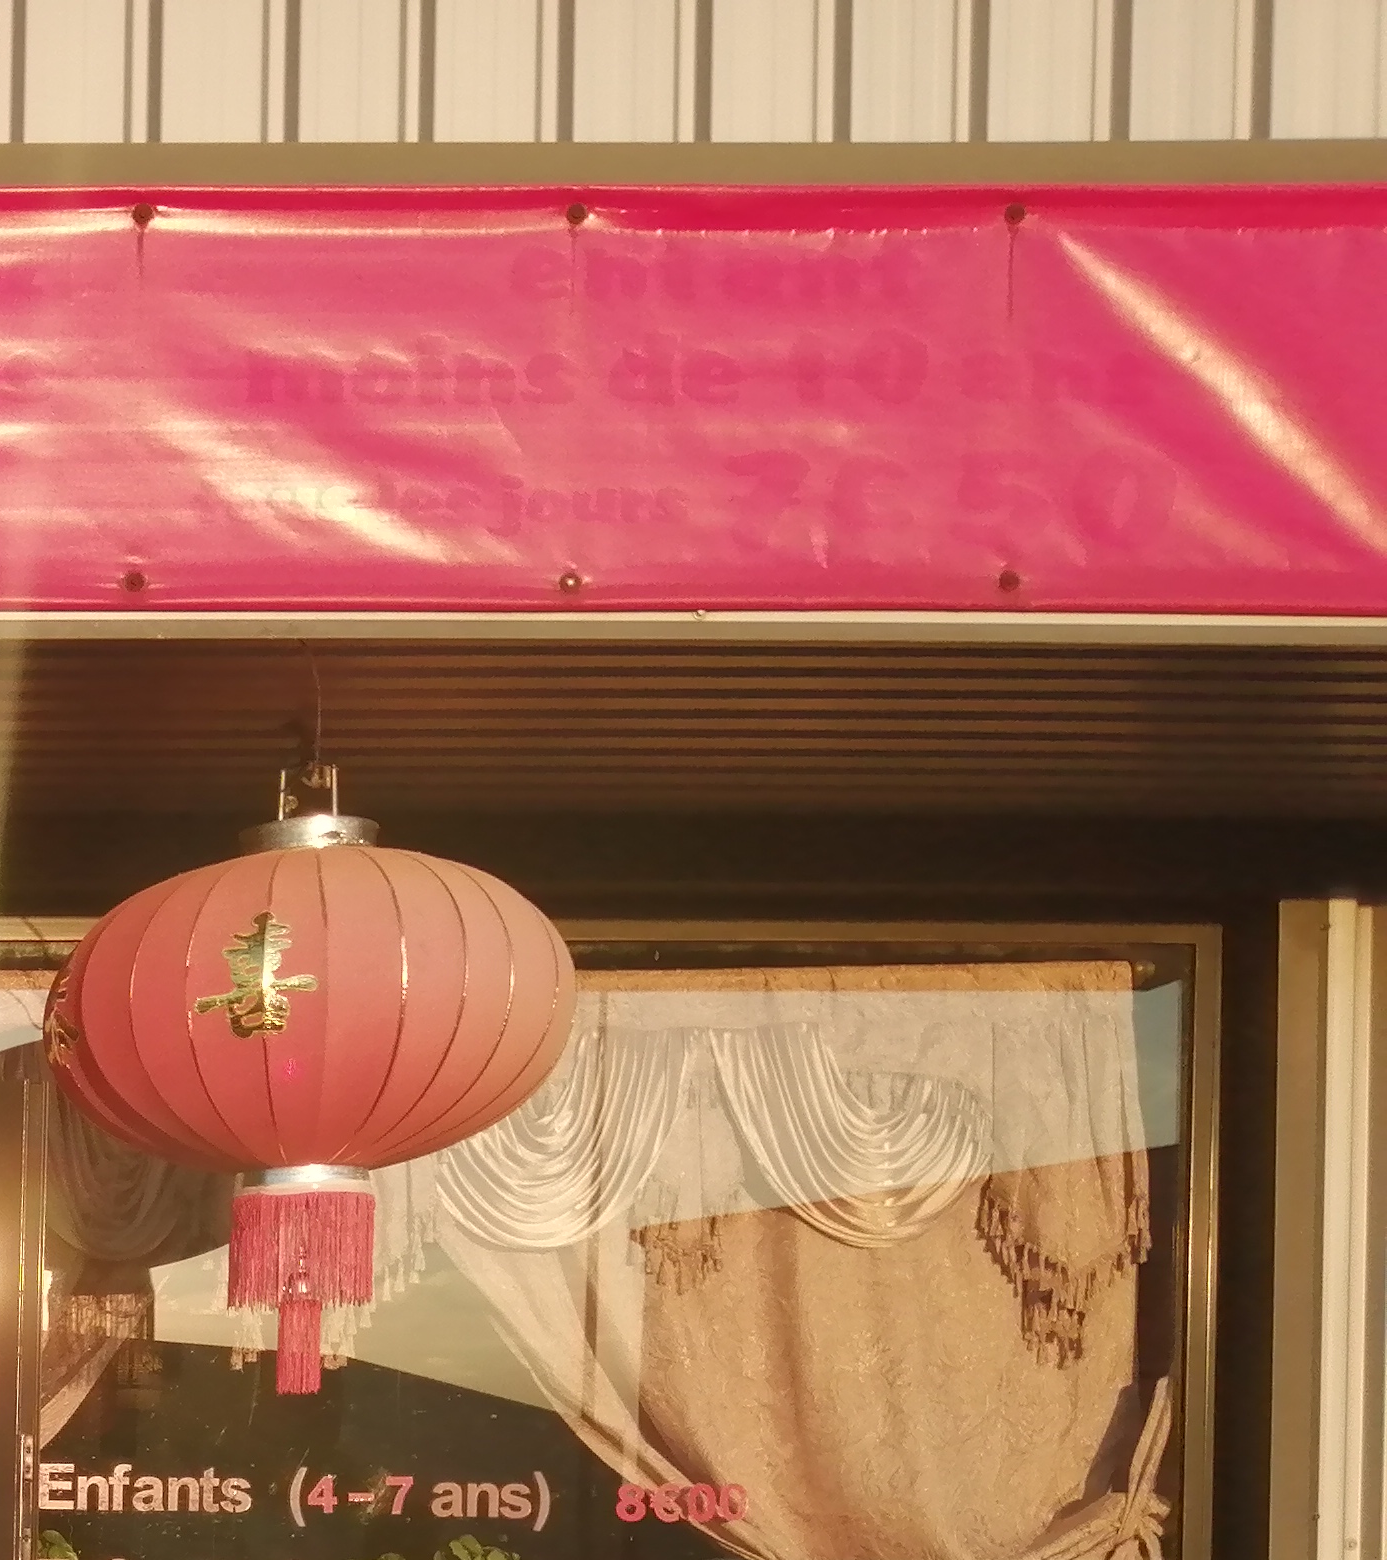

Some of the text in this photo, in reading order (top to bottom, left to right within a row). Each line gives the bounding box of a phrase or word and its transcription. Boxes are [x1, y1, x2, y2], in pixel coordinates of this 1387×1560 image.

[38, 1463, 253, 1513] Enfants
[430, 1471, 552, 1532] ans)
[615, 1483, 749, 1523] 8€00
